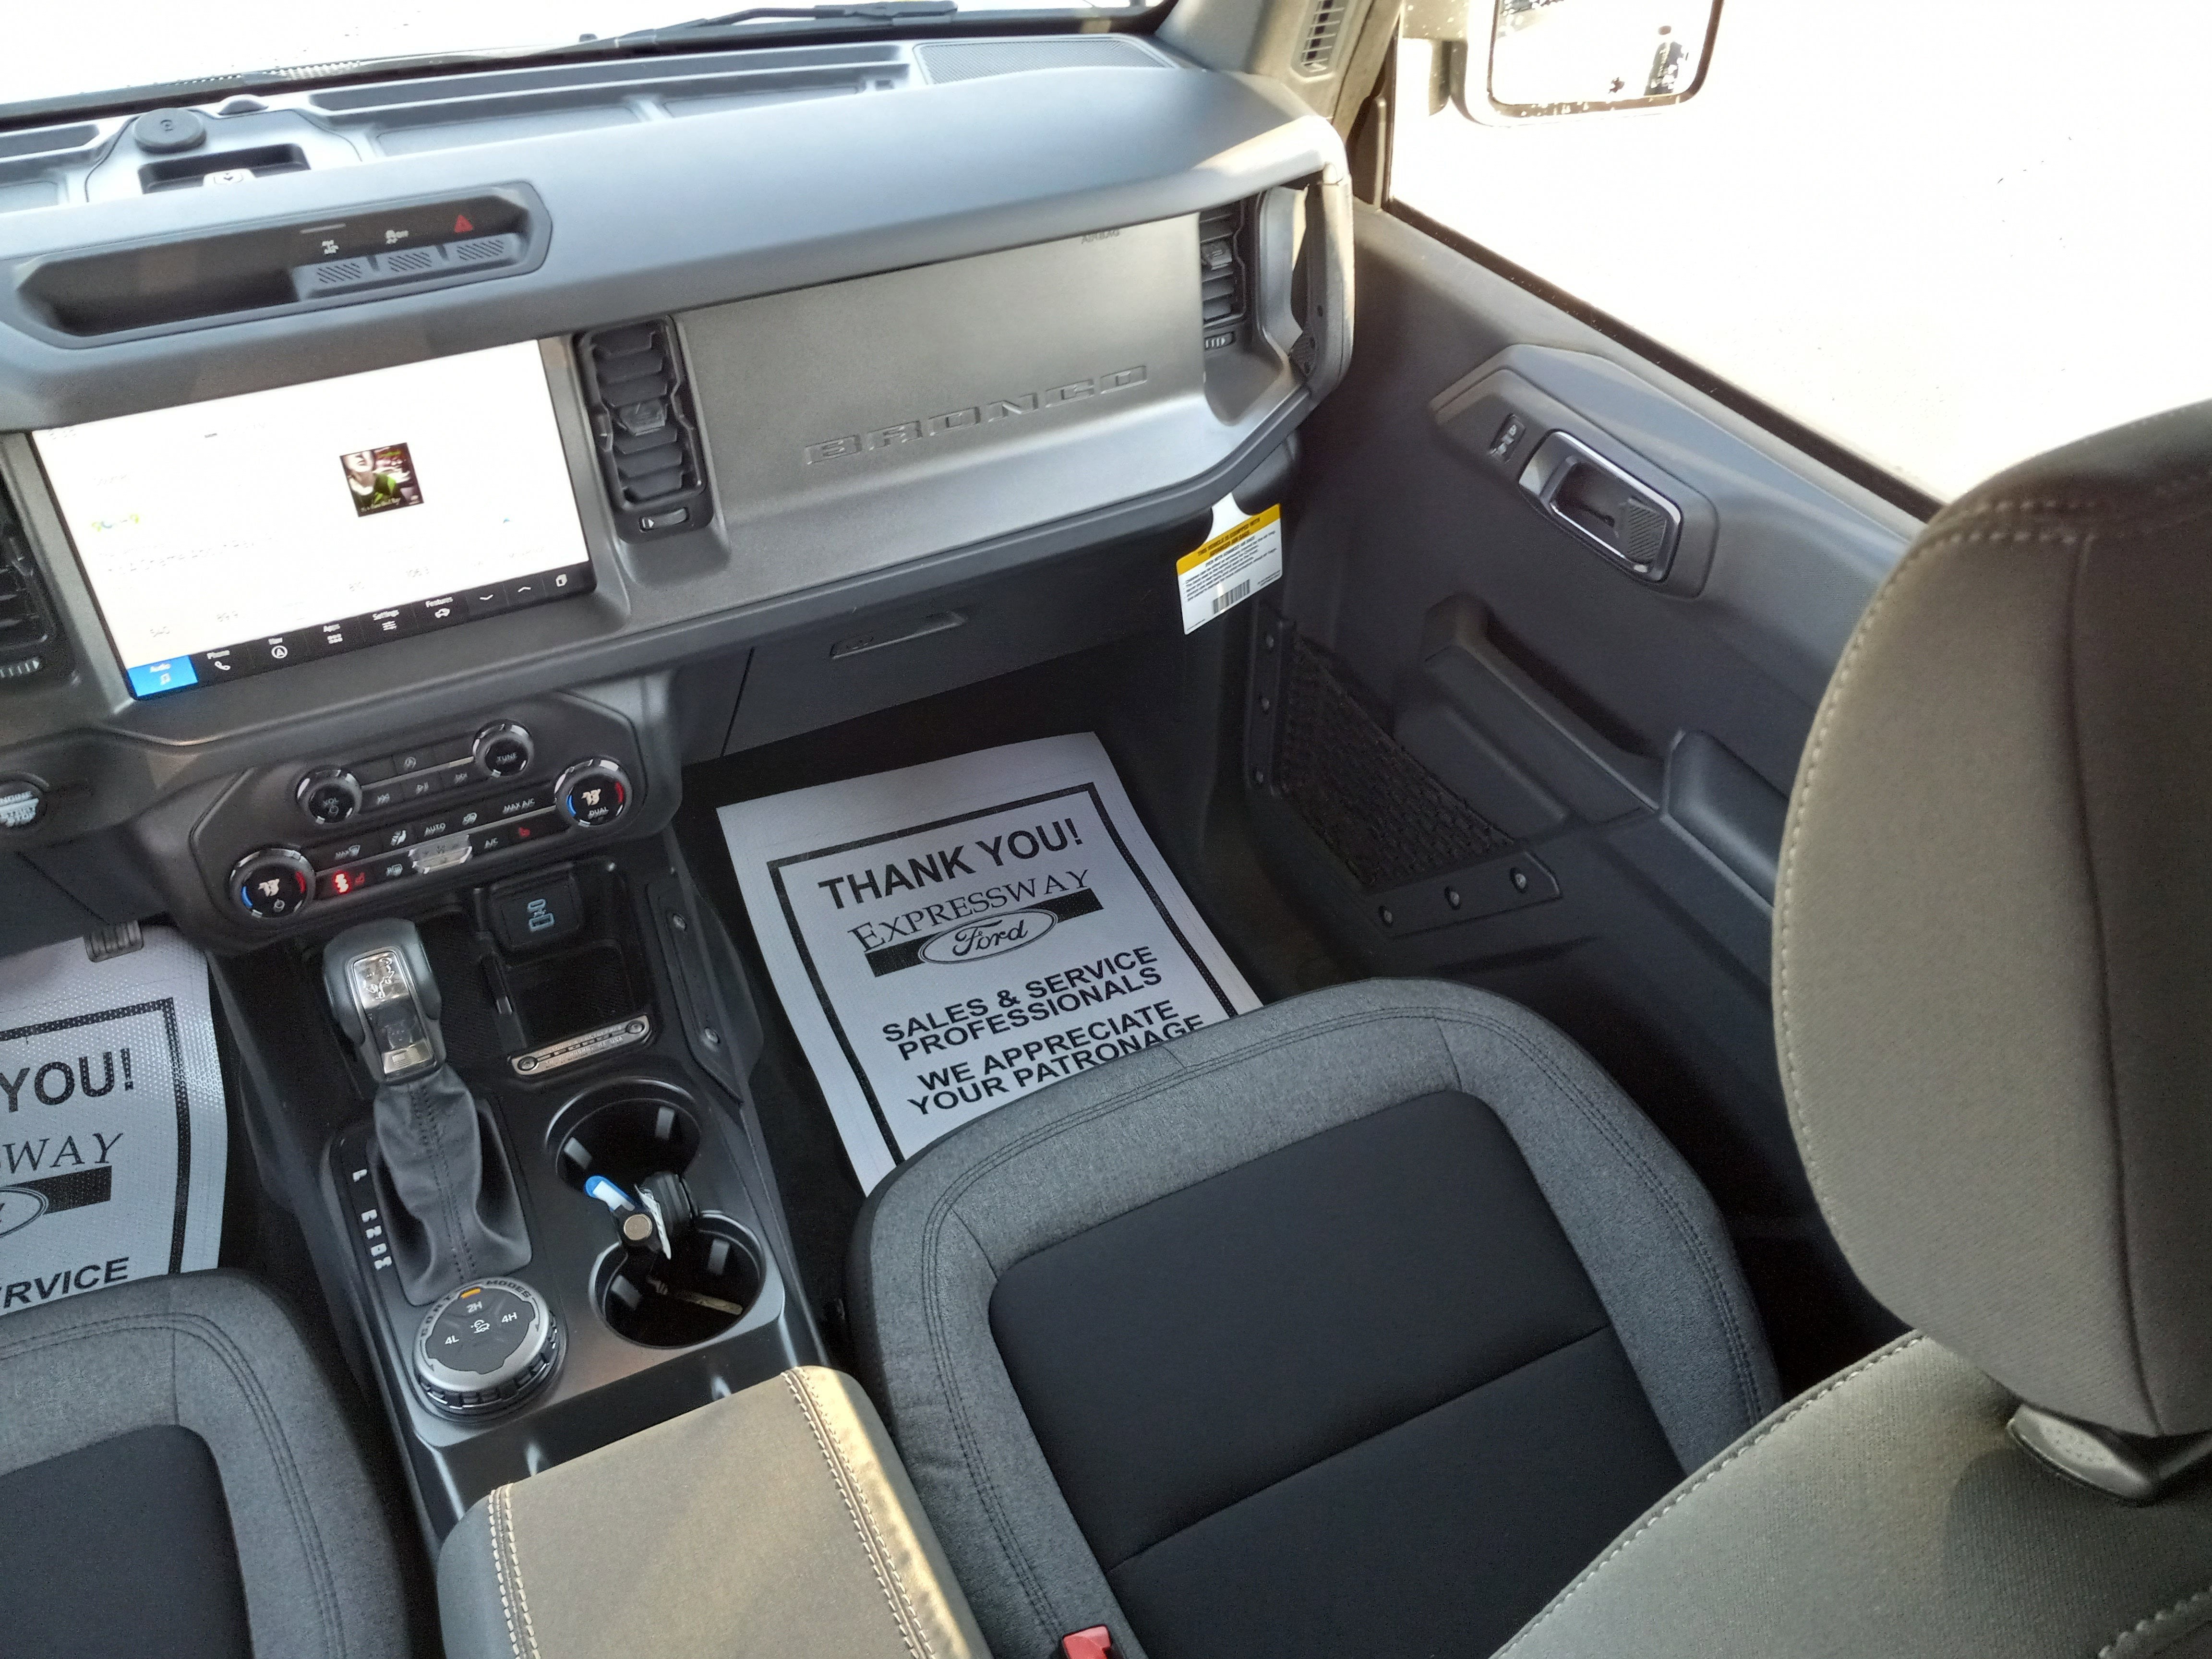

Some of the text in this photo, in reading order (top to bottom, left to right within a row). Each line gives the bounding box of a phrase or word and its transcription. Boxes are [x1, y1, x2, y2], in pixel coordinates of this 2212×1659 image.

[805, 366, 1147, 464] BRONCO
[425, 597, 454, 608] Features
[323, 796, 339, 807] VOL
[503, 798, 535, 814] MAX A/C
[588, 806, 609, 819] DUAL
[424, 823, 445, 836] AUTO
[484, 838, 499, 849] A/C
[817, 818, 1083, 909] THANK YOU!
[847, 869, 1089, 952] EXPRESSWAY
[952, 920, 1028, 956] Ford
[882, 947, 1157, 1042] SALES & SERVICE
[898, 967, 1162, 1061] PROFESSIONALS
[917, 1000, 1178, 1090] WE APPRECIATE
[907, 1014, 1204, 1115] YOUR PATRONAGE
[0, 1048, 133, 1112] YOU!
[0, 1133, 123, 1174] WAY
[353, 1169, 367, 1182] P
[361, 1209, 377, 1223] R
[366, 1226, 382, 1239] N
[0, 1257, 129, 1309] RVICE
[486, 1280, 531, 1298] MODES
[466, 1301, 482, 1313] 2H
[501, 1312, 517, 1323] 4H
[445, 1335, 460, 1345] 4L
